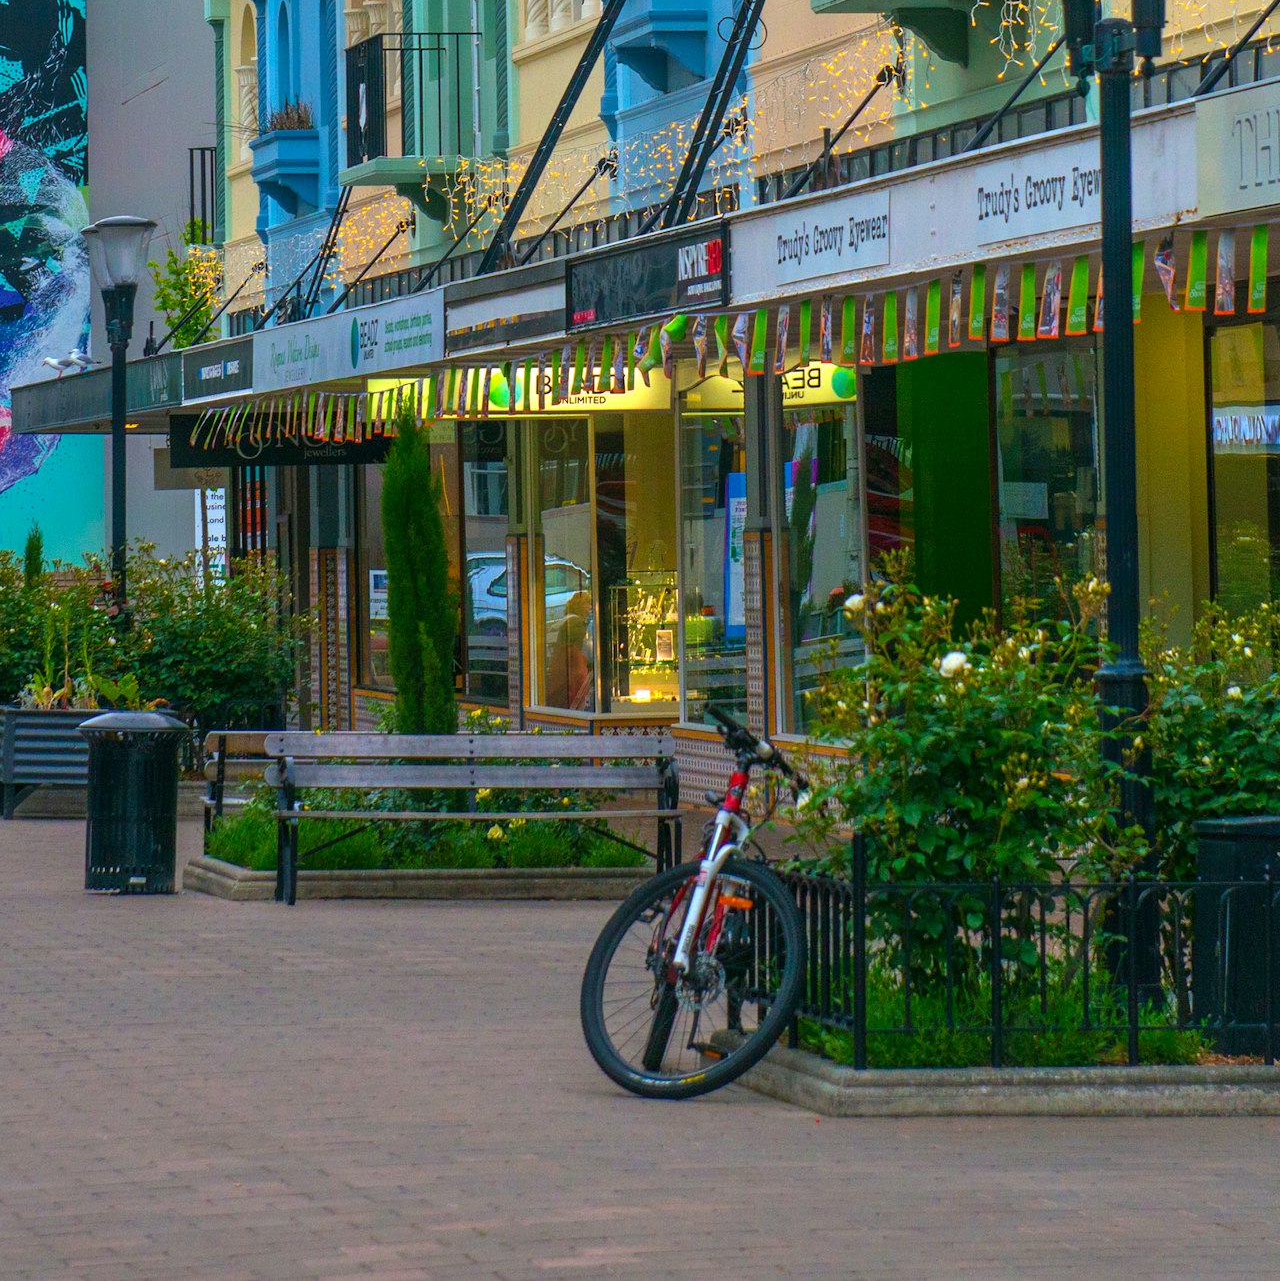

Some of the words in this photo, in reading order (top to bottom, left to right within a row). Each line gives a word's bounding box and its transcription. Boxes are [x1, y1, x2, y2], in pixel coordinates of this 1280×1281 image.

[977, 174, 1019, 223] Trudy's
[1025, 175, 1065, 211] Groovy
[1071, 166, 1102, 208] Eyew
[777, 222, 810, 265] Trudy's
[813, 224, 845, 257] Groovy
[848, 213, 889, 248] Eyewear
[303, 445, 347, 460] jewellers
